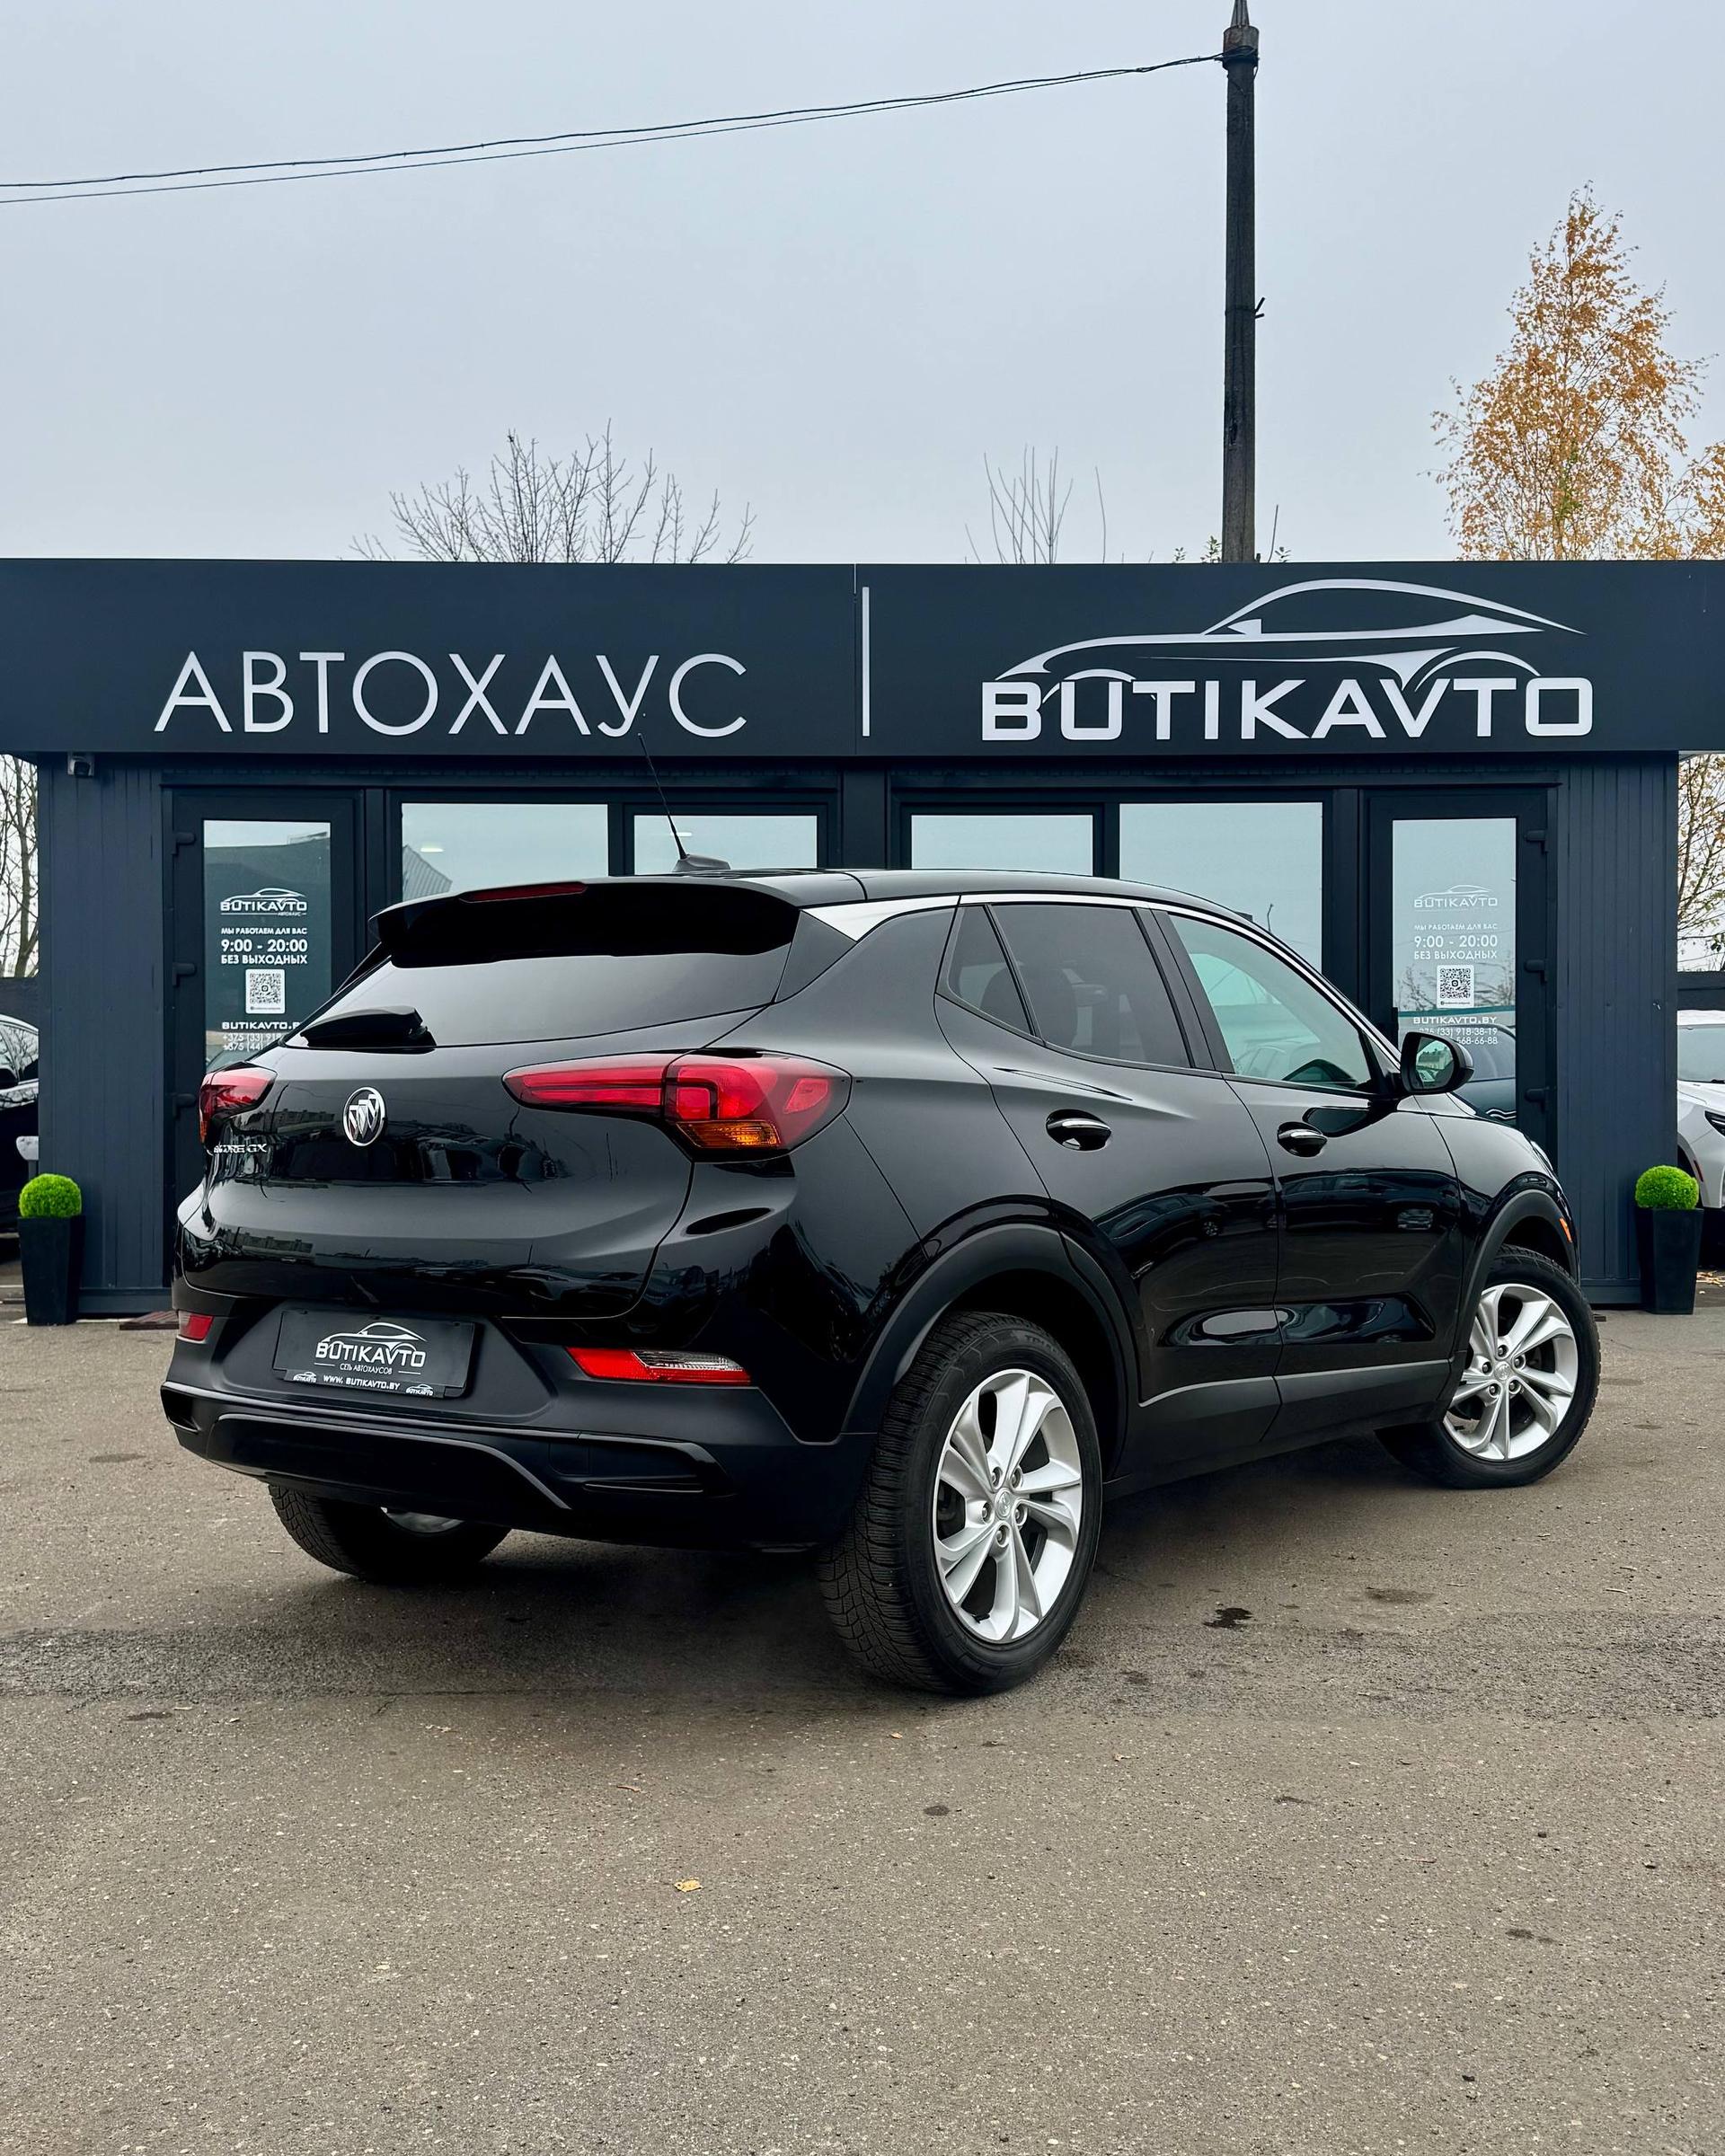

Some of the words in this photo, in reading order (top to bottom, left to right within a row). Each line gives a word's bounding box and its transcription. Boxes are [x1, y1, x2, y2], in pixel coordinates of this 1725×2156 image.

[154, 650, 748, 738] АВТОХАУС
[982, 676, 1593, 741] BUTIKAVTO
[219, 901, 307, 912] BUTIKAVTO
[1414, 897, 1498, 908] BUTIKAVTO
[275, 927, 290, 935] ДЛЯ
[221, 939, 252, 952] 9:00
[267, 939, 308, 952] 20:00
[1414, 935, 1444, 948] 9:00
[1459, 934, 1499, 948] 20:00
[221, 954, 240, 965] БЕЗ
[242, 954, 308, 966] ВЫХОДНЫХ
[1414, 950, 1431, 960] БЕЗ
[1434, 950, 1498, 960] ВЫХОДНЫХ
[1413, 1016, 1498, 1024] BUTIKAVTO.BY
[1455, 1027, 1499, 1036] 918-38-19
[246, 1144, 267, 1153] GX
[315, 1342, 426, 1368] BUTIKAVTO
[340, 1363, 352, 1371] СЕТЬ
[353, 1365, 393, 1374] АВТОХАУСОВ
[323, 1374, 343, 1384] WWW.
[346, 1377, 401, 1391] BUTIKAVTO.BY
